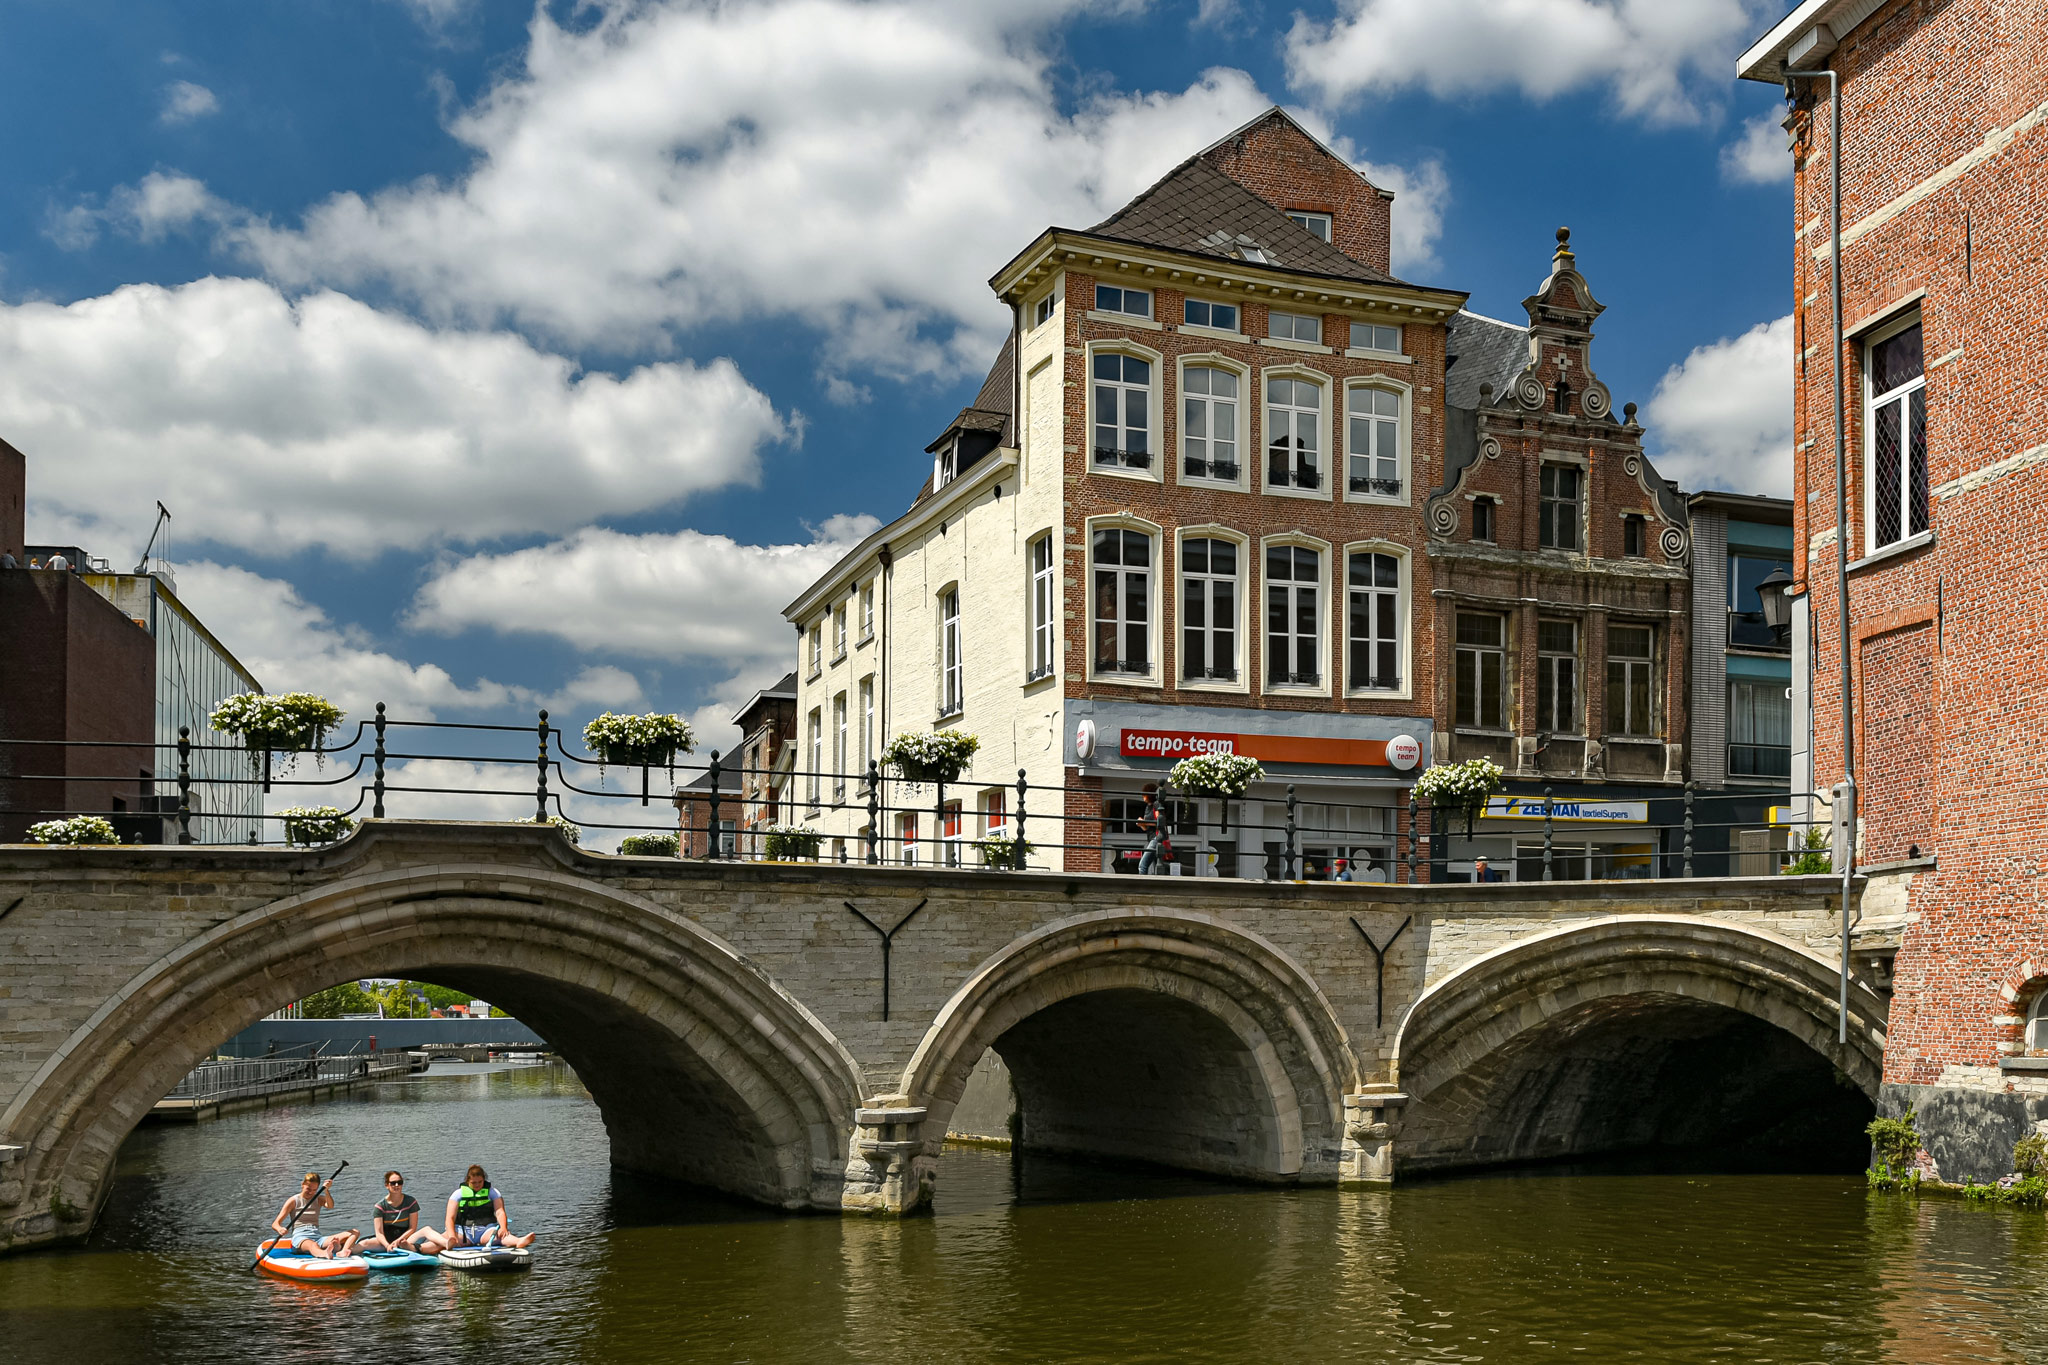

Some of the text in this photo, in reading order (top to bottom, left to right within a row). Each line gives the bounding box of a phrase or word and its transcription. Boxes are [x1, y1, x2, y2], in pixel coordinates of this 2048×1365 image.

[1127, 733, 1233, 756] tempo-team
[1395, 745, 1417, 753] tempo
[1582, 808, 1629, 820] textielSupers
